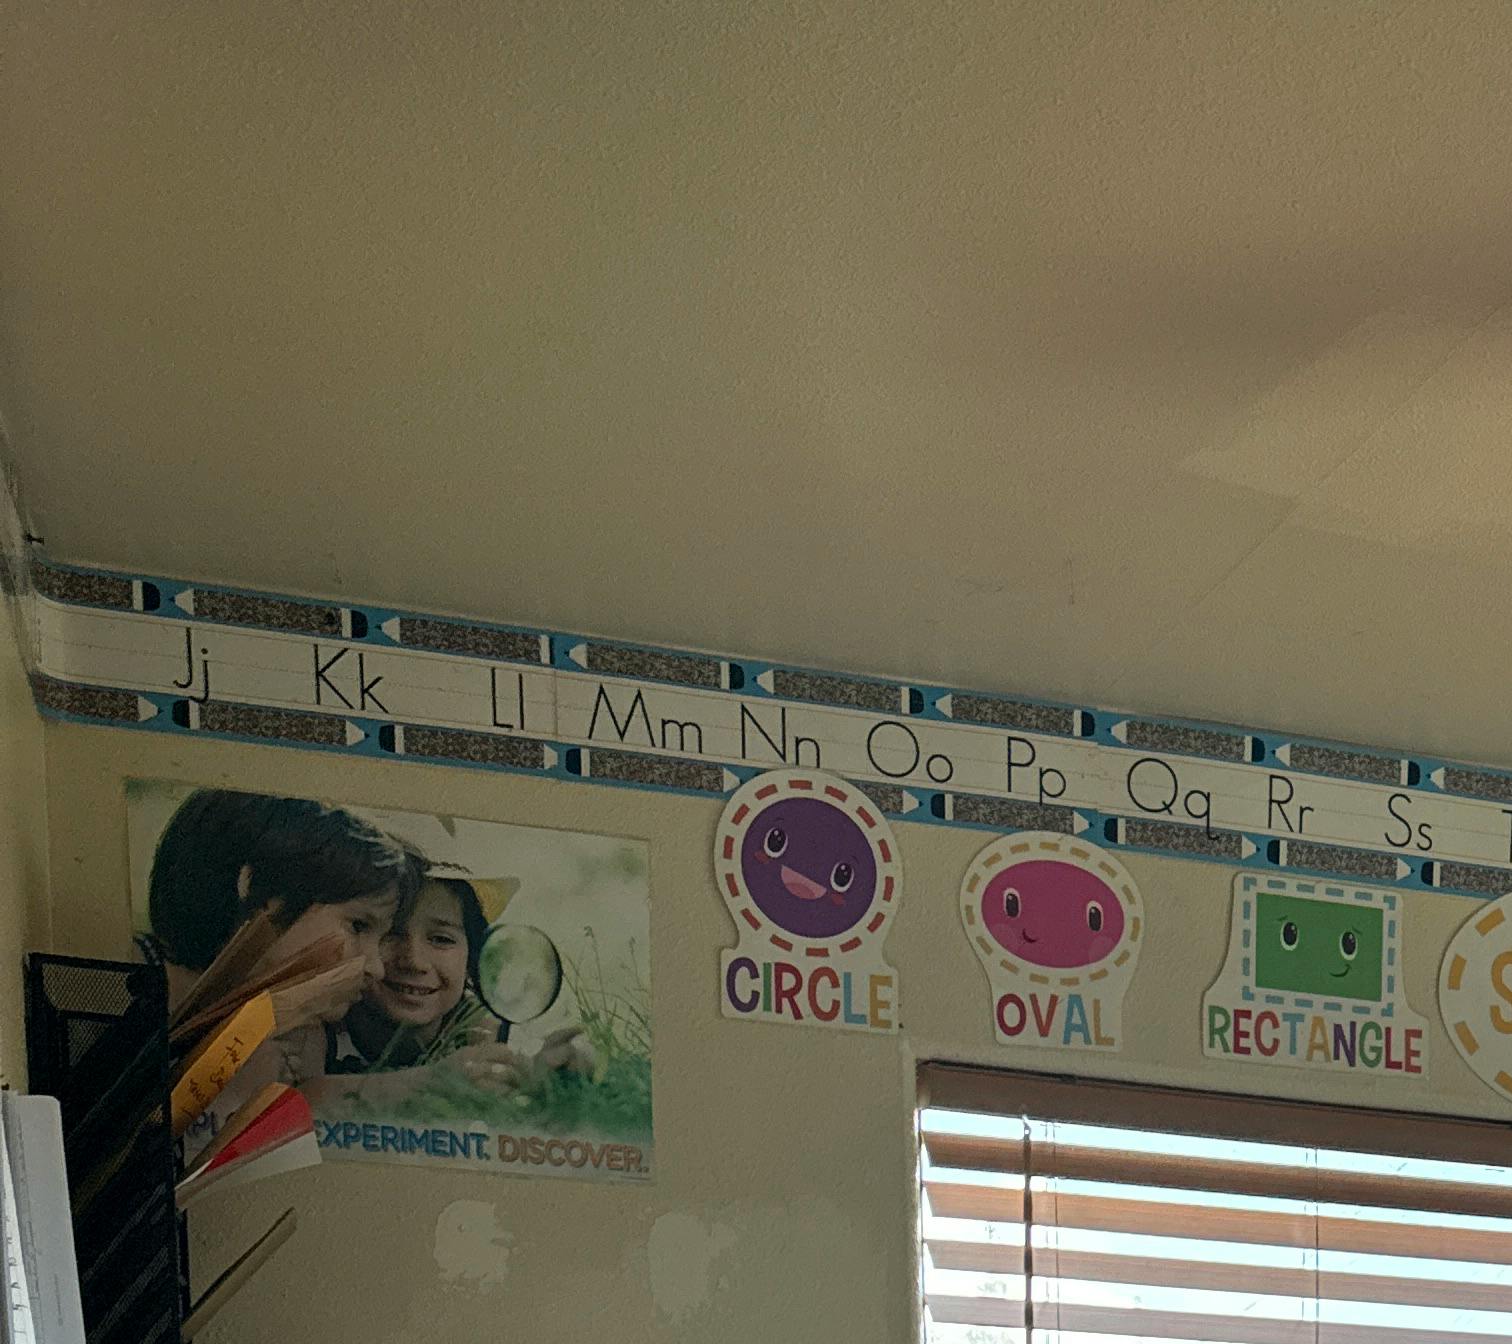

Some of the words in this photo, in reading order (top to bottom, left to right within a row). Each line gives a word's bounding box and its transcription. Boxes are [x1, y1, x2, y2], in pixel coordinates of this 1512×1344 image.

[173, 626, 209, 703] Jj
[313, 643, 389, 713] Kk
[491, 666, 525, 731] Ll
[588, 683, 703, 753] Mm
[740, 702, 821, 768] Nn
[866, 720, 954, 783] Oo
[1006, 736, 1067, 806] Pp
[1127, 758, 1220, 841] Qq
[1267, 774, 1314, 834] Rr
[1384, 793, 1434, 851] Ss
[726, 957, 893, 1029] CIRCLE
[996, 993, 1115, 1046] OVAL
[1208, 1005, 1423, 1074] RECTANGLE
